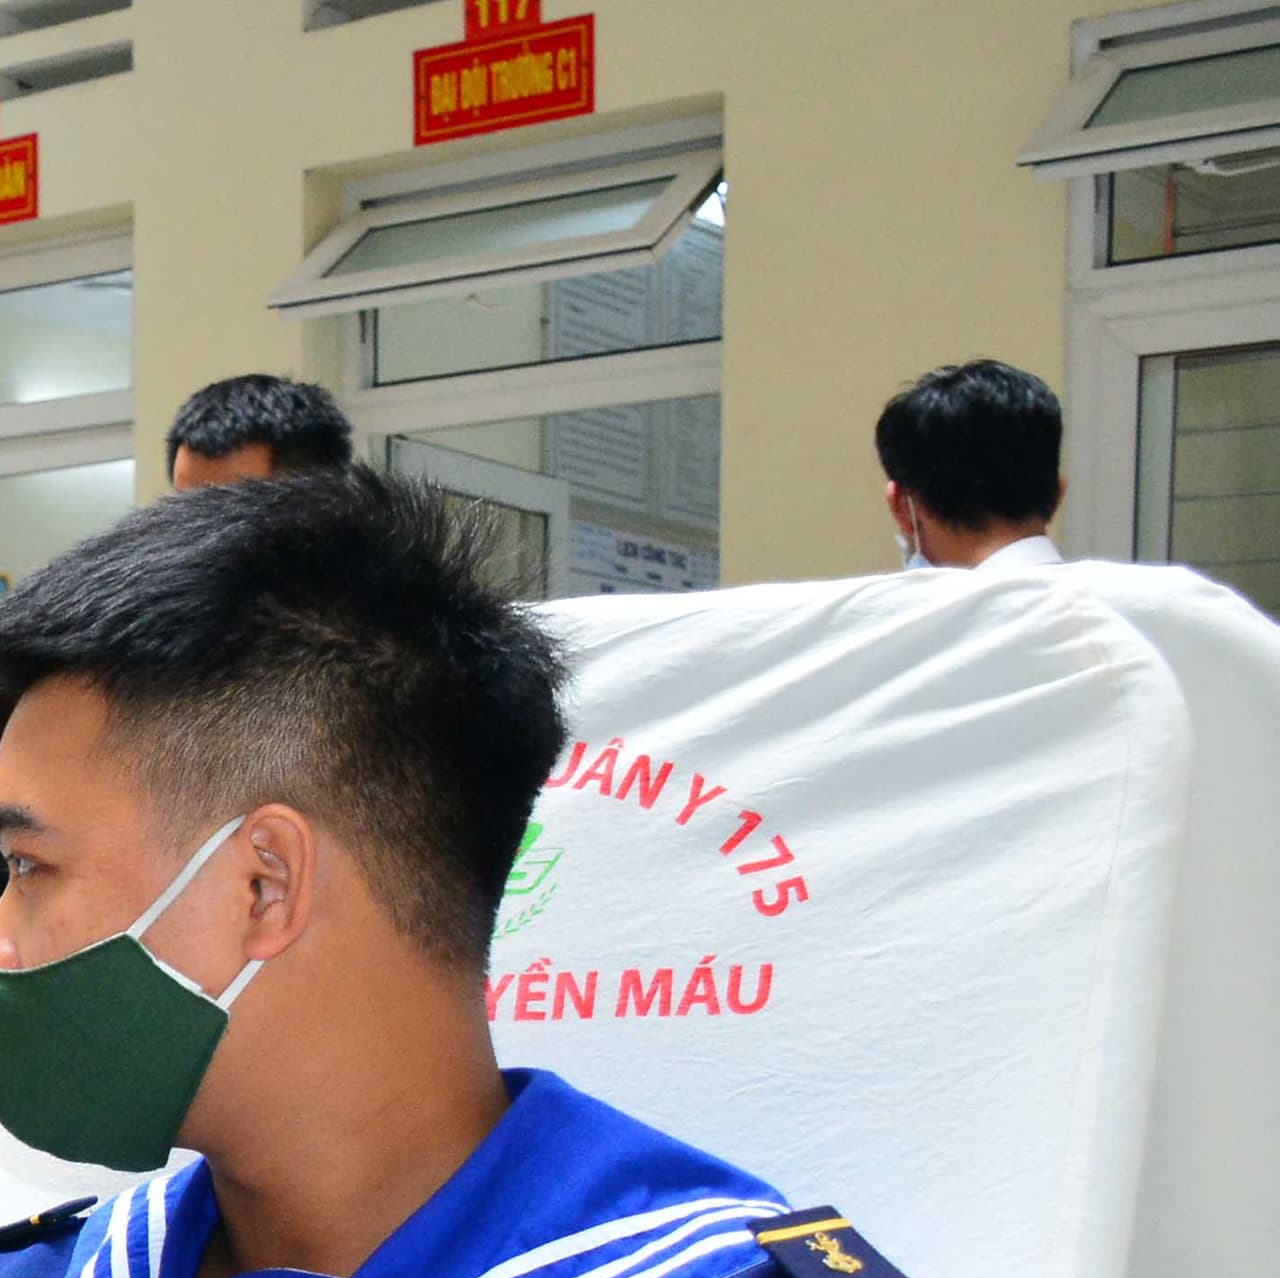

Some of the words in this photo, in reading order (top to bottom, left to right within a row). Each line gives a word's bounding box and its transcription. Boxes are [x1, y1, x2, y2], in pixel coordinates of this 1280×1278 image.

[556, 47, 577, 91] C1
[543, 736, 674, 811] UÂN
[675, 772, 728, 827] Y
[718, 809, 810, 918] 175
[484, 956, 600, 1022] YỀN
[614, 953, 775, 1018] MÁU
